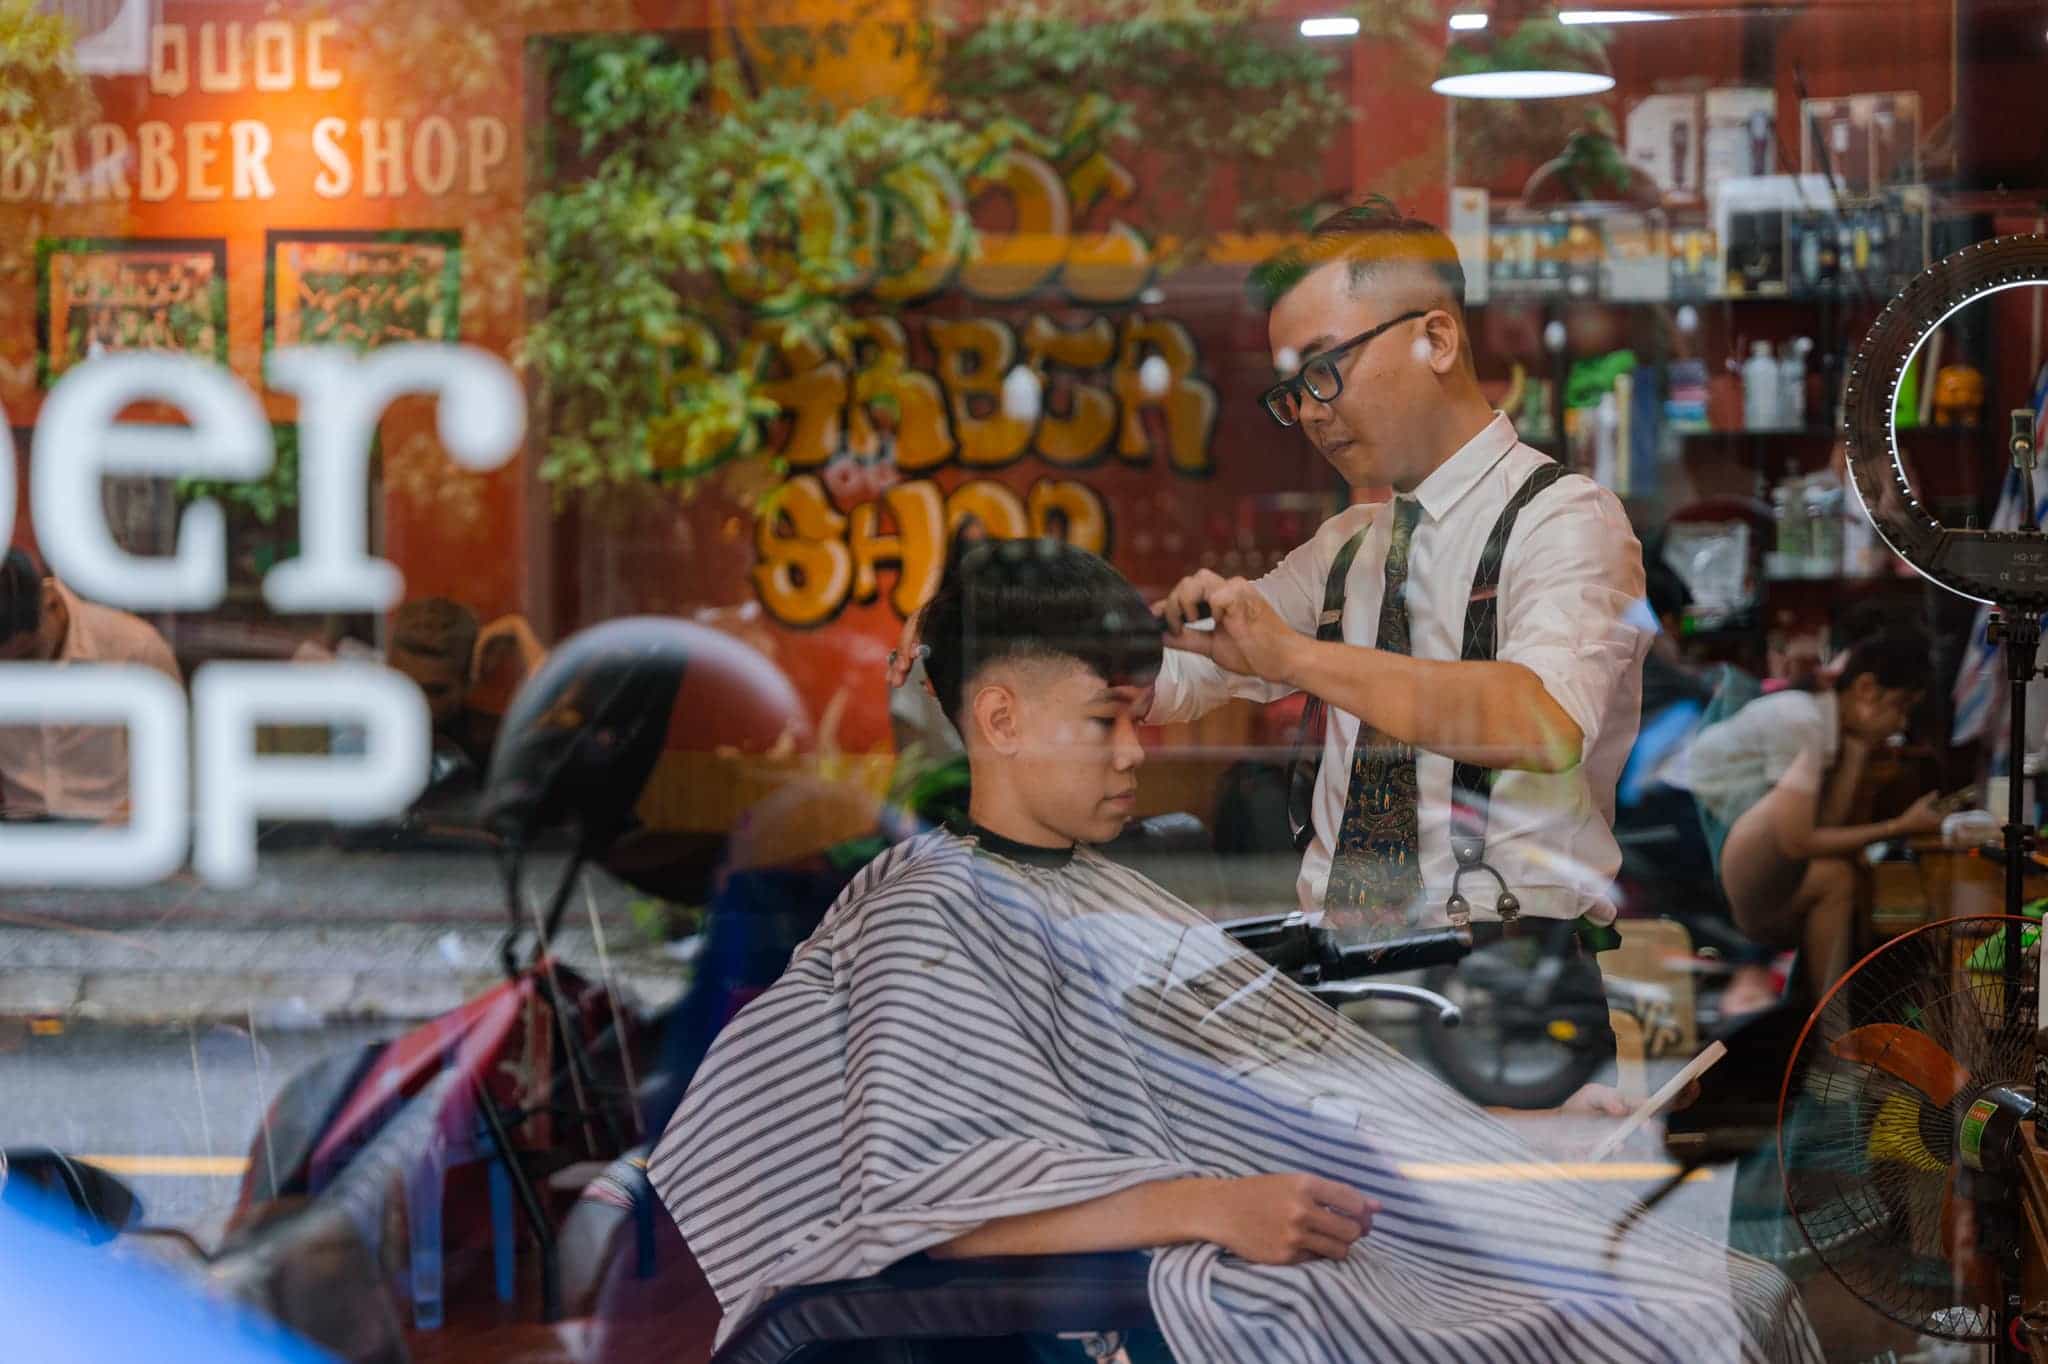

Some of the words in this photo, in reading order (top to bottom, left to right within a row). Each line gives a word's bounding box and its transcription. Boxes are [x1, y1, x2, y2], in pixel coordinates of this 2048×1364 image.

[0, 119, 276, 204] BARBER
[312, 115, 509, 199] SHOP
[0, 342, 528, 614] er
